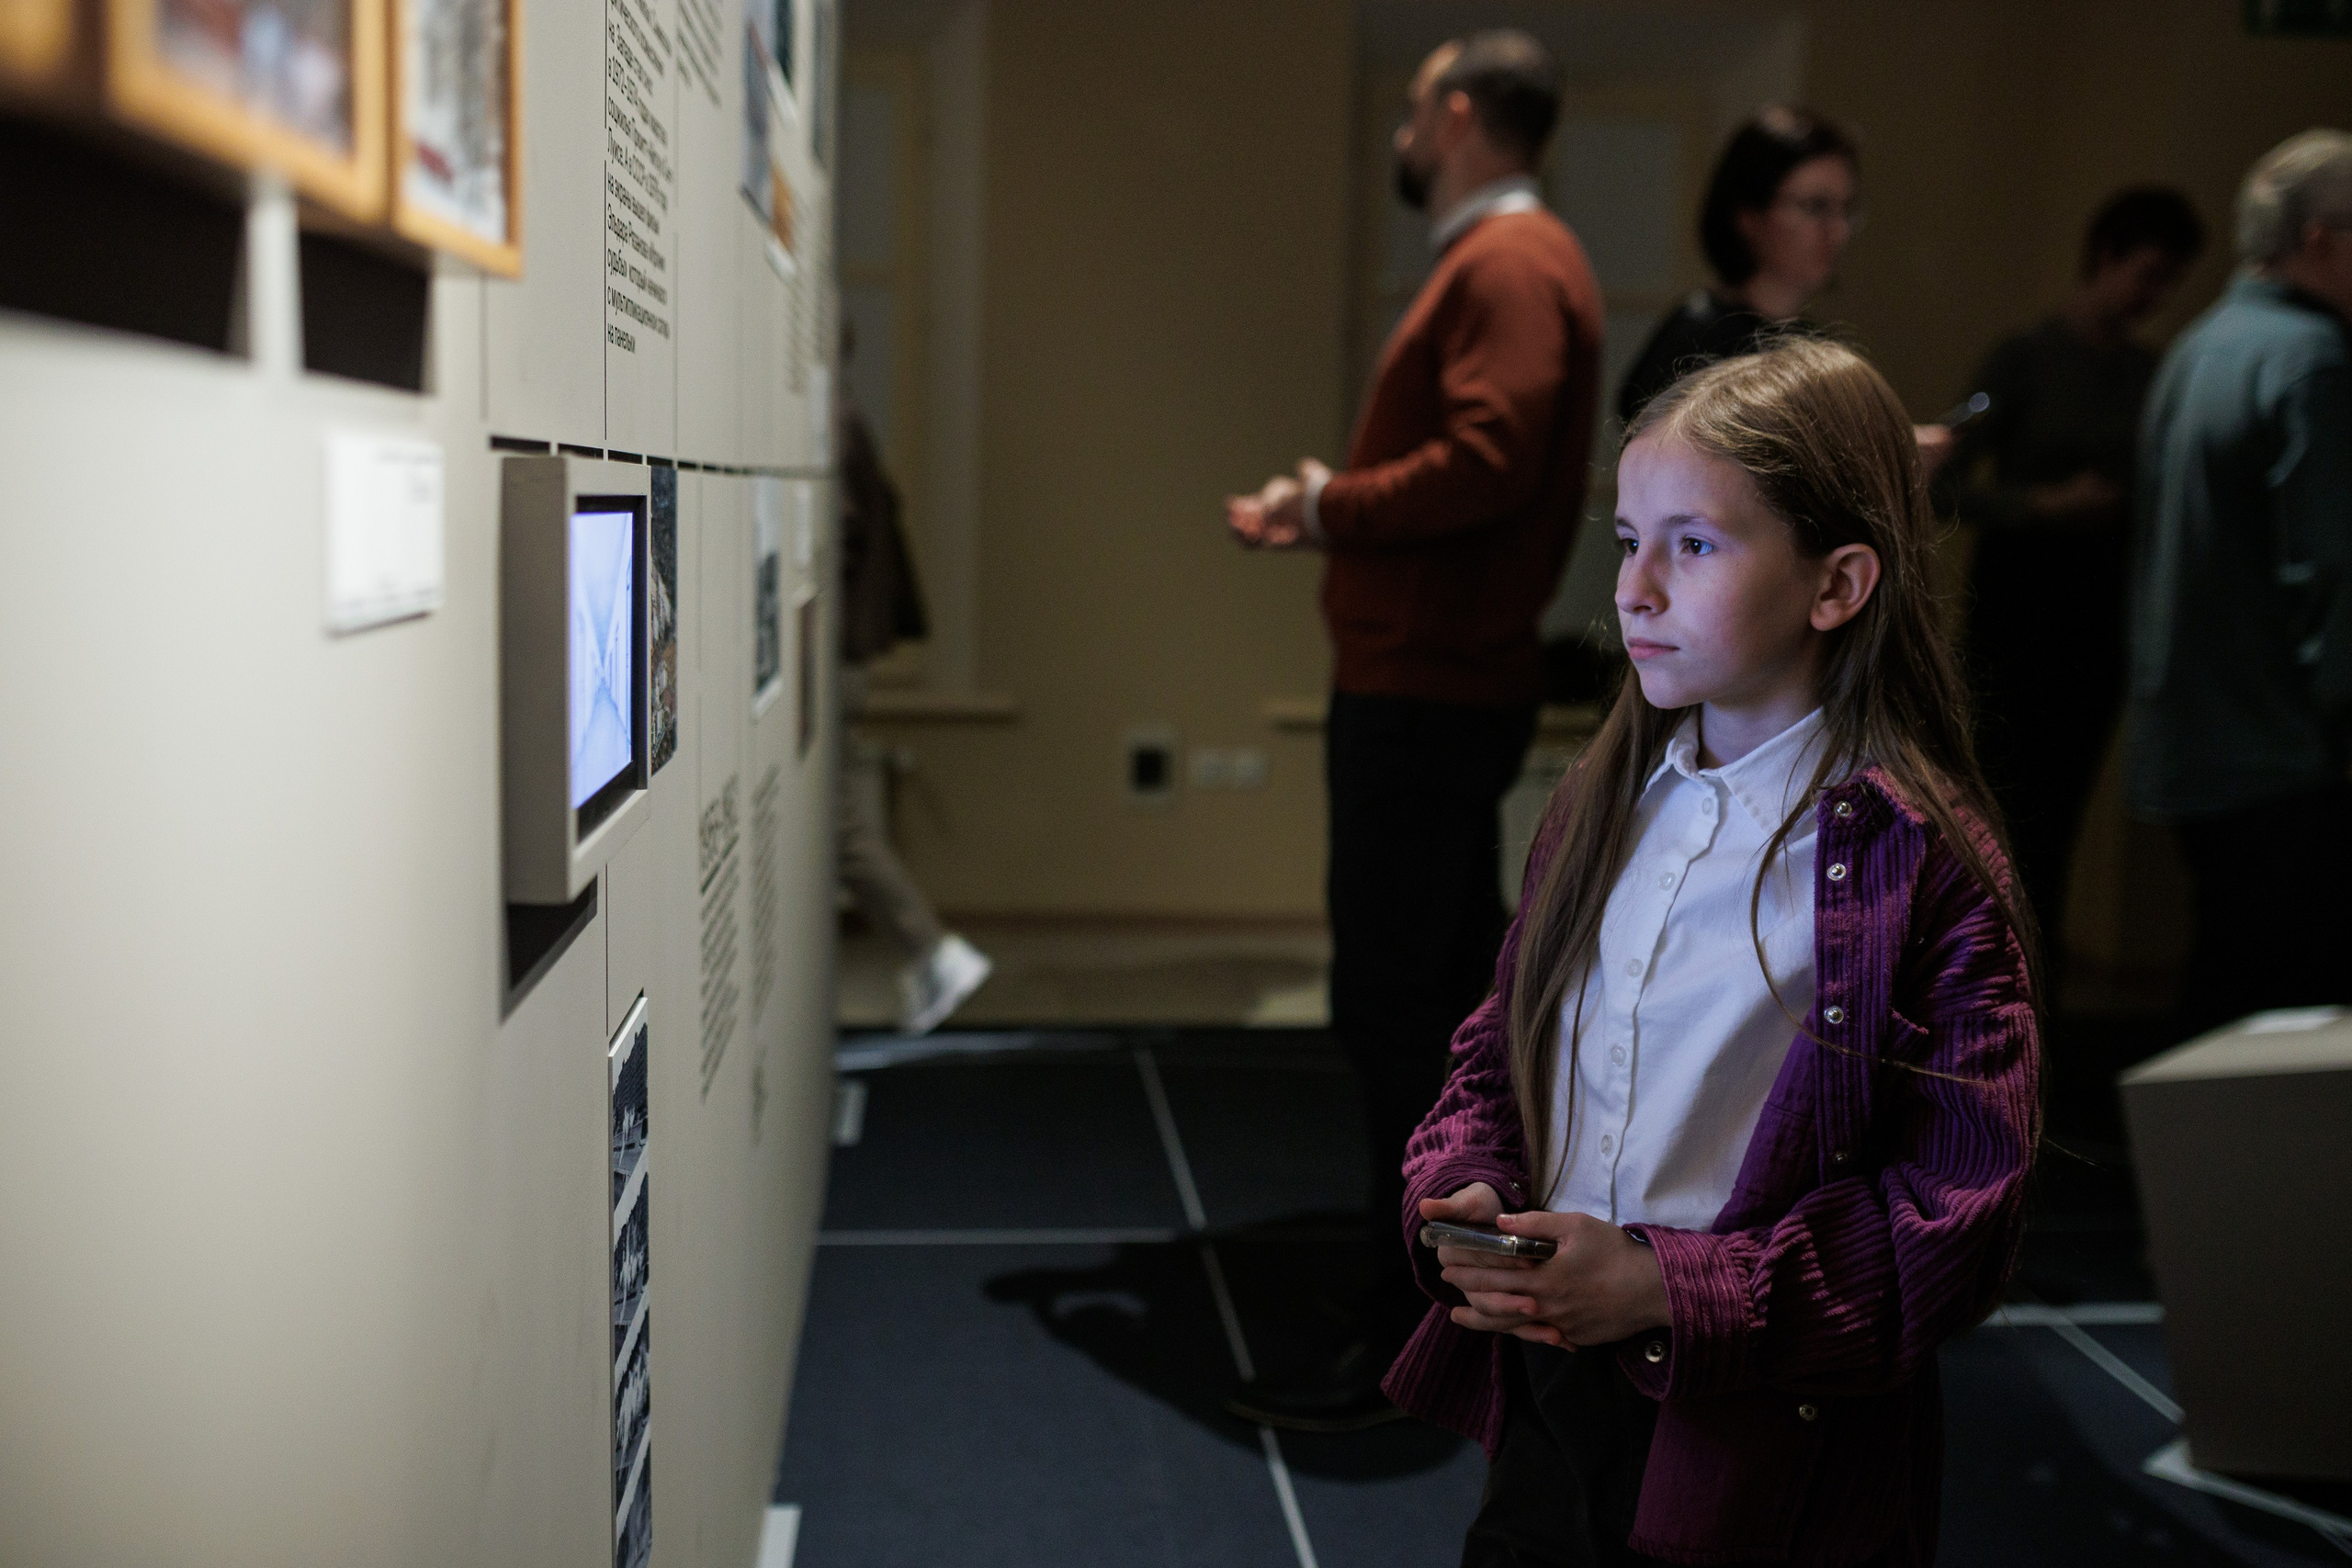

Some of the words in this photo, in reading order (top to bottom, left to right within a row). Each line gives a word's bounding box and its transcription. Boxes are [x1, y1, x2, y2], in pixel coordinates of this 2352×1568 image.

[608, 18, 614, 43] на
[608, 172, 614, 195] на
[615, 178, 631, 209] экраны
[607, 203, 628, 247] Эльдара
[607, 286, 611, 305] с
[607, 323, 614, 344] на
[615, 326, 636, 354] панельки
